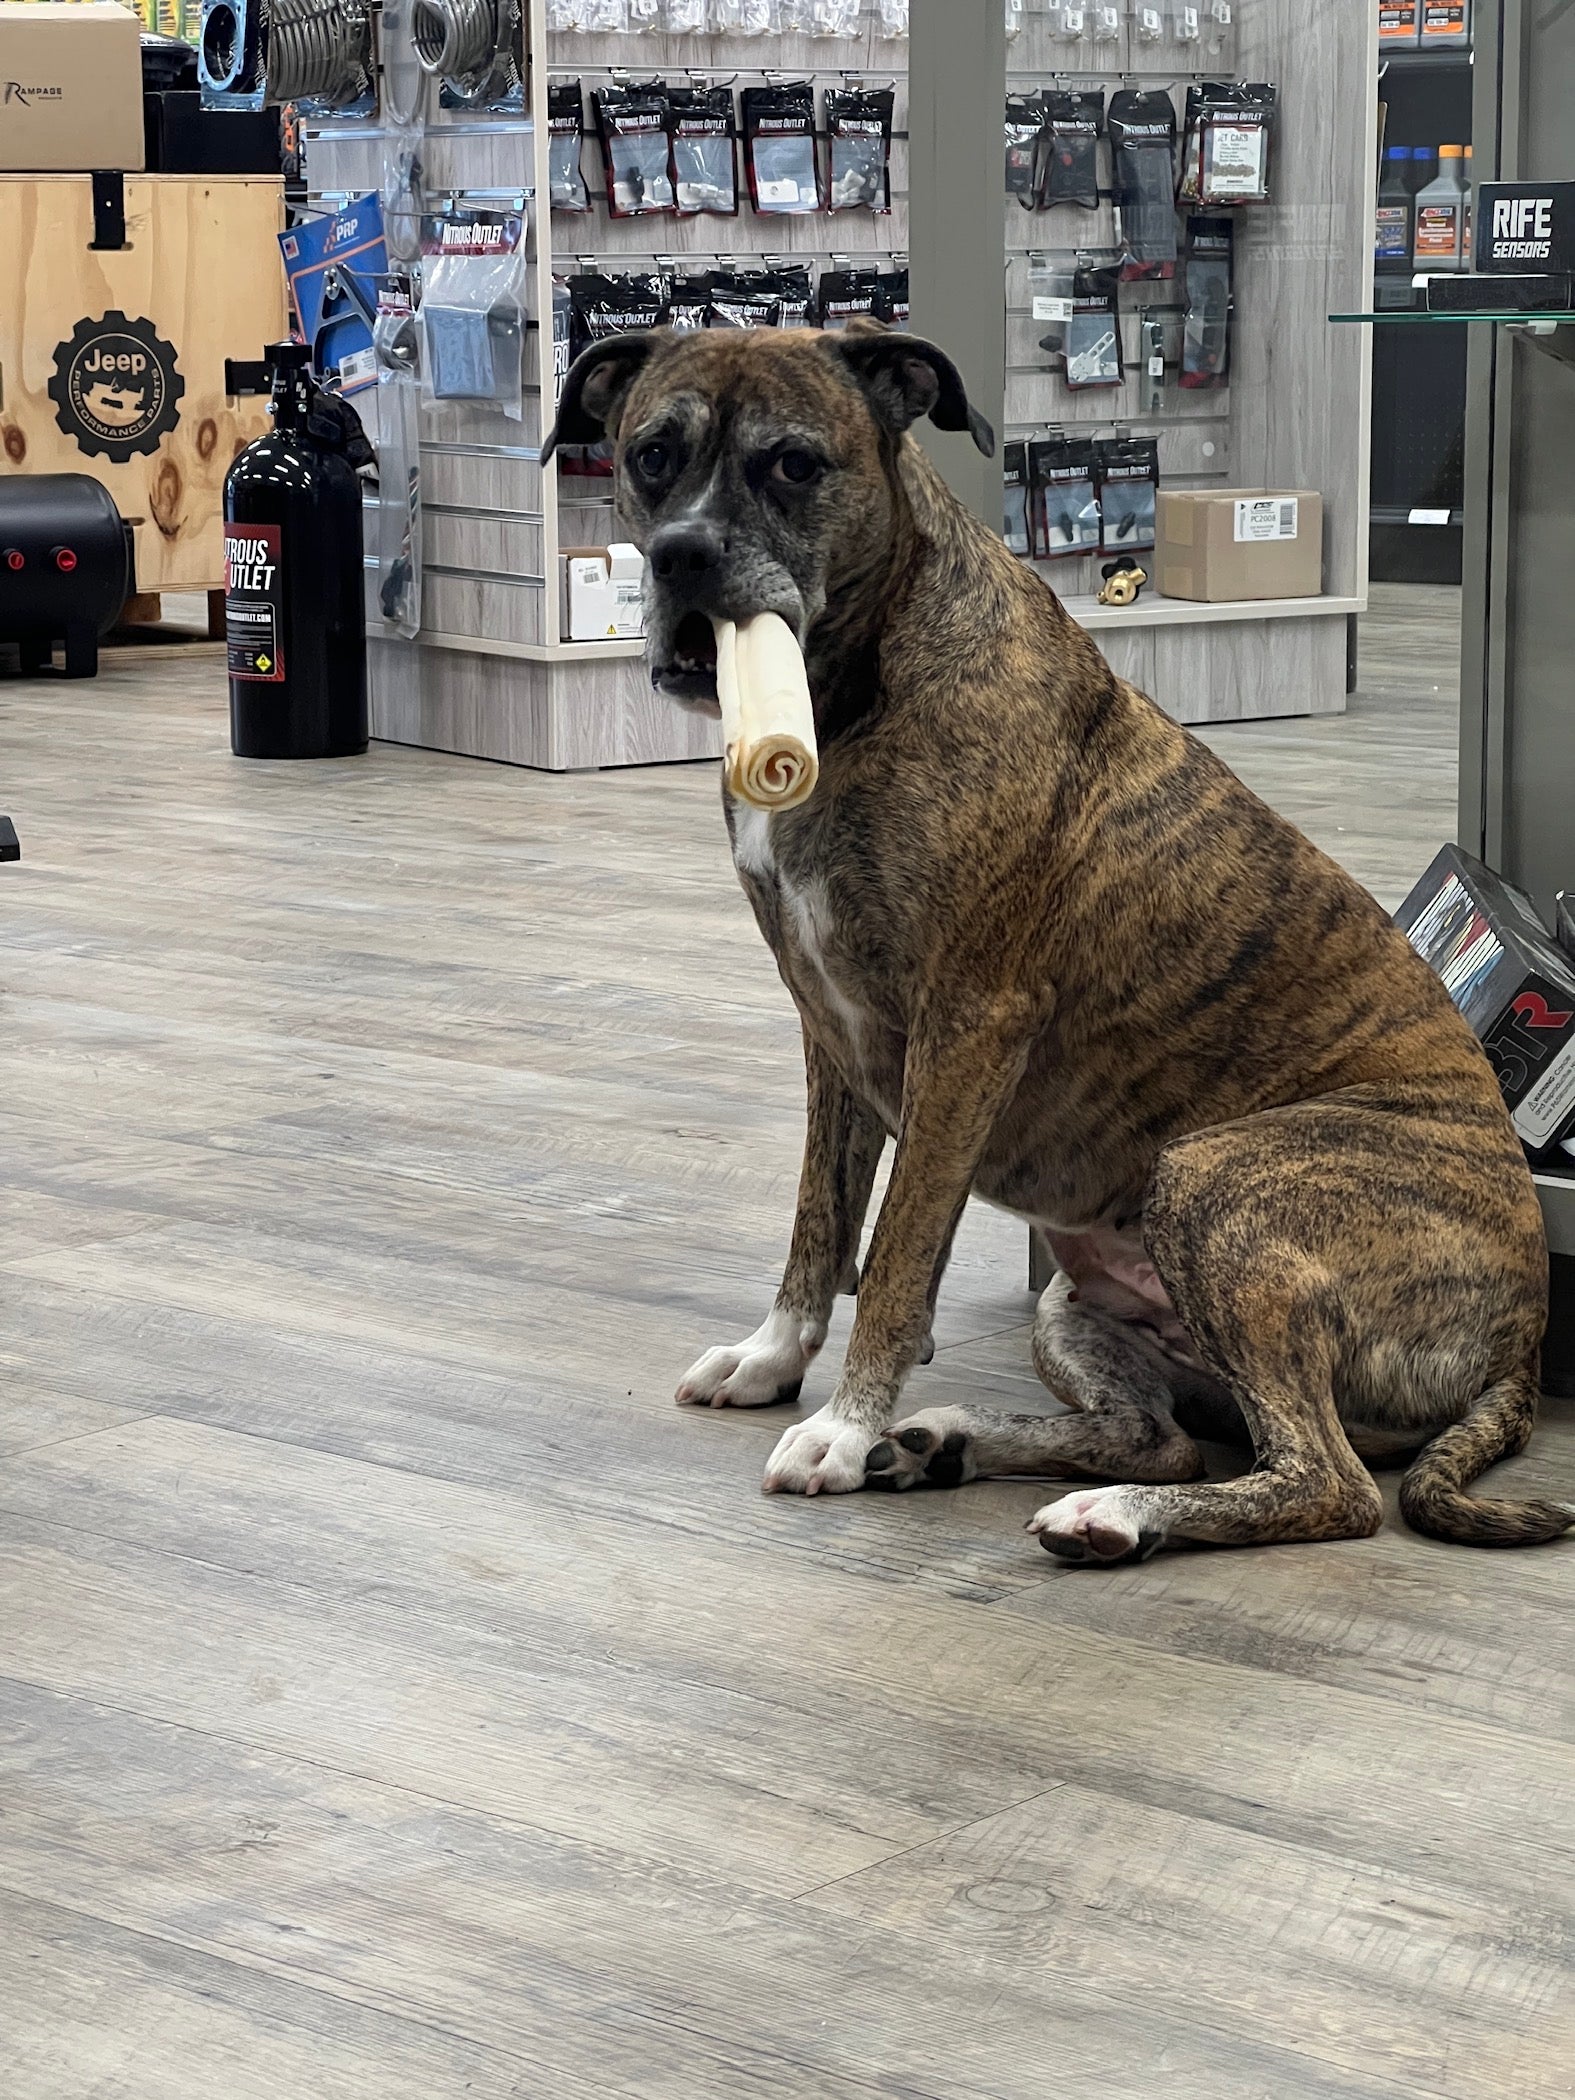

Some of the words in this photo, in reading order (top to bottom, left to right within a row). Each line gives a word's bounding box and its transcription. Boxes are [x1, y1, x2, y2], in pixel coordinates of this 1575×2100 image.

[4, 81, 62, 107] RAMPAGE
[639, 115, 661, 125] OUTLET
[679, 119, 703, 129] NITROUS
[704, 119, 726, 129] OUTLET
[759, 118, 782, 128] NITROUS
[783, 118, 806, 128] OUTLET
[1212, 111, 1239, 121] NITROUS
[1240, 111, 1262, 121] OUTLET
[1493, 199, 1553, 238] RIFE
[336, 218, 358, 241] PRP
[442, 223, 471, 244] NITROUS
[471, 222, 503, 244] OUTLET
[1493, 241, 1551, 259] SENSORS
[744, 305, 768, 316] OUTLET
[829, 301, 850, 310] NITROUS
[851, 298, 872, 309] OUTLET
[590, 310, 624, 324] NITROUS
[625, 312, 657, 324] OUTLET
[84, 349, 147, 376] Jeep
[72, 370, 147, 437] PERFORMANCE
[147, 368, 161, 418] PARTS
[1070, 466, 1088, 476] OUTLET
[225, 537, 268, 565] TROUS
